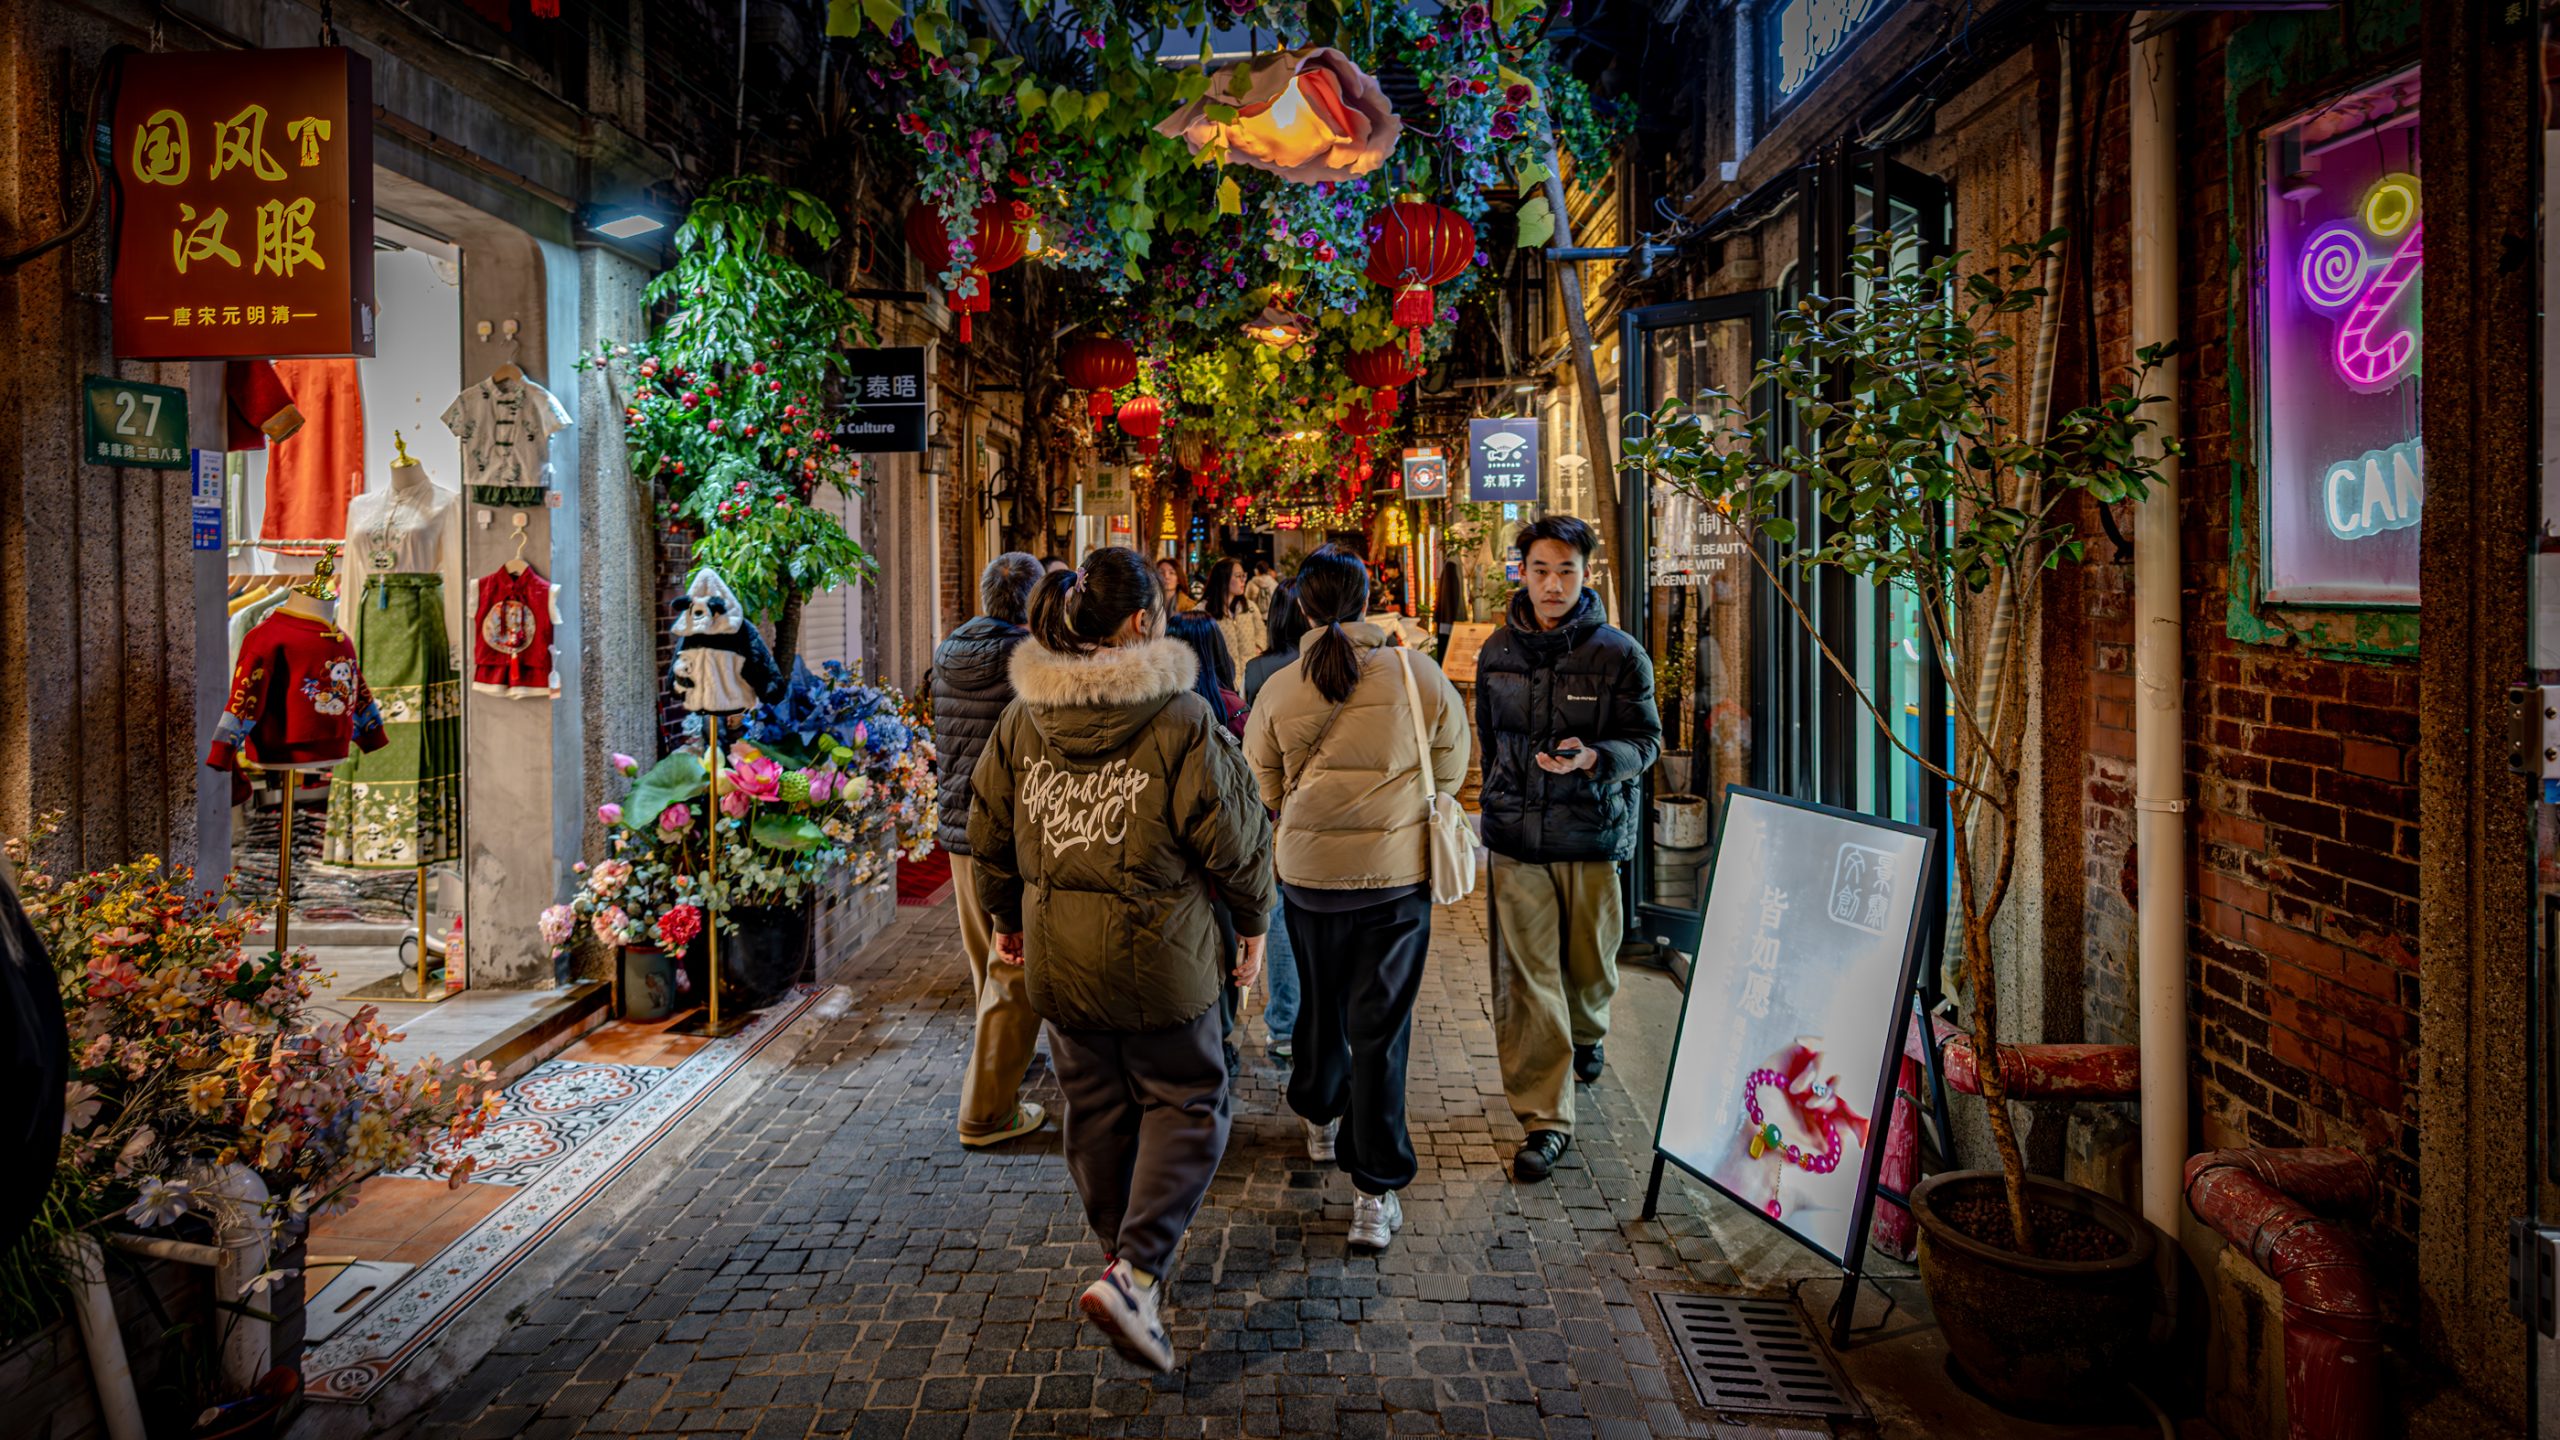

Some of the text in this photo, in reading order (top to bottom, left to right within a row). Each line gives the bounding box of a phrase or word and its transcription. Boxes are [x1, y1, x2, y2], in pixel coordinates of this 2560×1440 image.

[132, 104, 288, 186] 国风
[173, 197, 326, 278] 汉服
[173, 305, 290, 326] 唐宋元明清
[115, 391, 162, 437] 27
[847, 422, 896, 434] Culture
[1483, 474, 1526, 488] 京扇子
[1701, 542, 1748, 555] BEAUTY
[1695, 558, 1725, 570] WITH
[1650, 574, 1711, 587] INGENUITY
